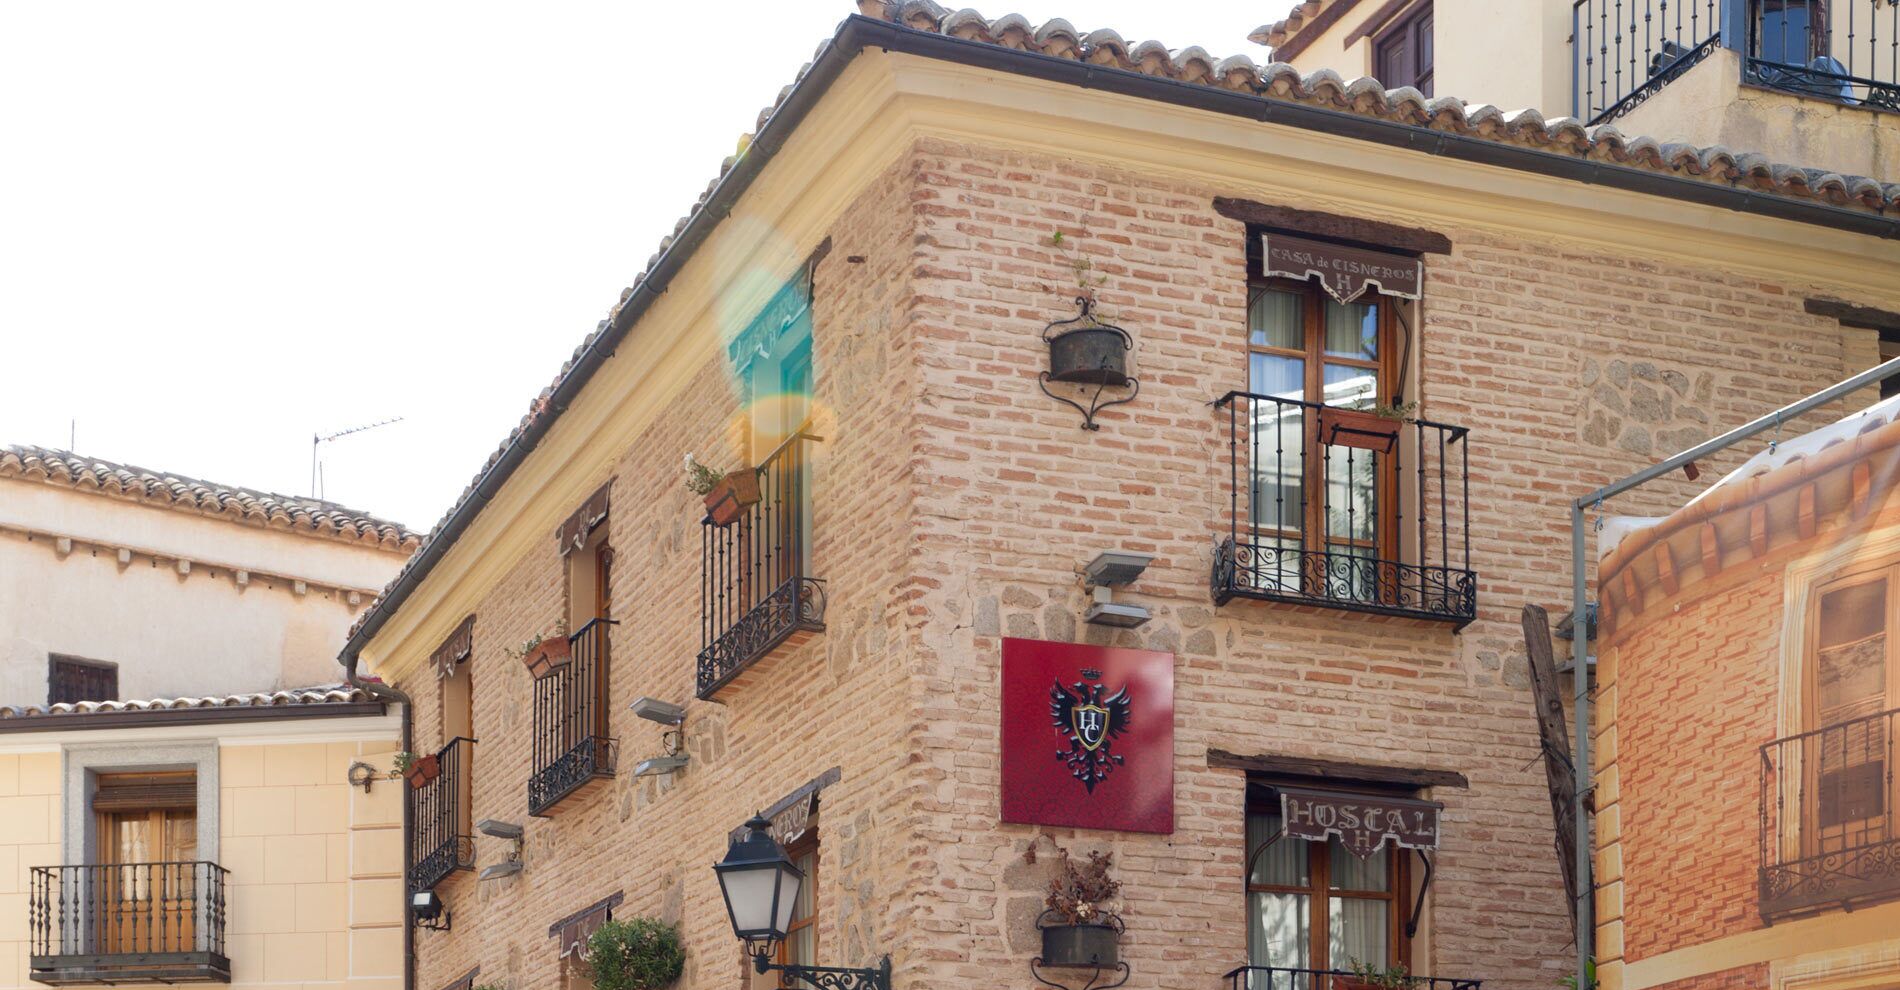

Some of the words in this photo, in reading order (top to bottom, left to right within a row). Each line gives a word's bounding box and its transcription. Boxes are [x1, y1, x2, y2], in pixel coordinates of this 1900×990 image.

[1271, 248, 1314, 266] CASA
[1317, 256, 1329, 268] de
[1332, 258, 1415, 281] CISNEROS
[1336, 273, 1352, 290] H
[1288, 799, 1434, 836] HOSTAL
[1354, 830, 1371, 847] H
